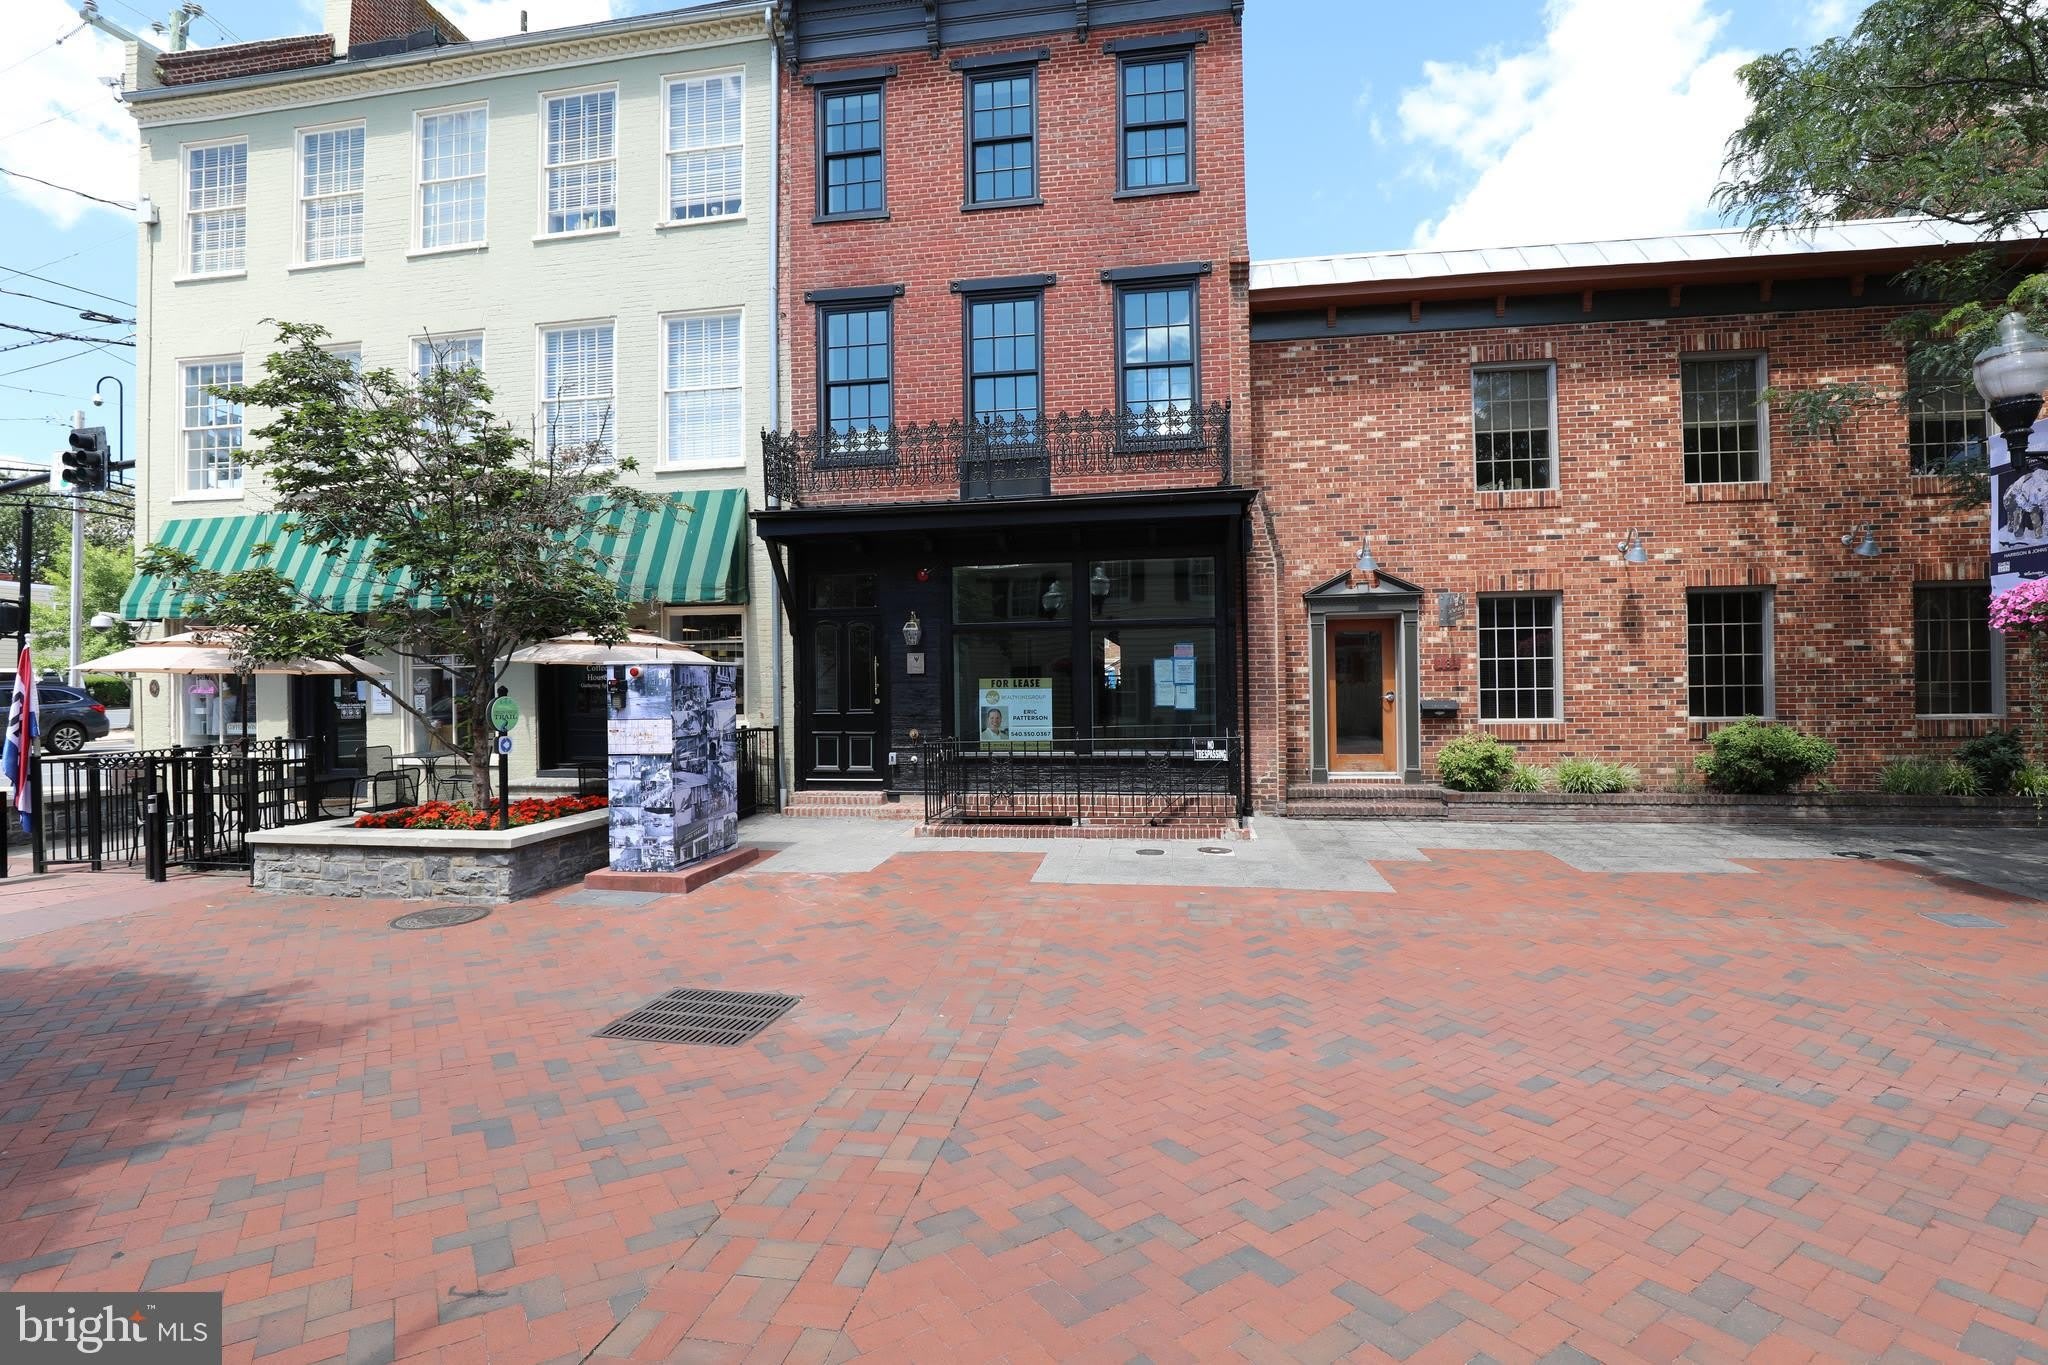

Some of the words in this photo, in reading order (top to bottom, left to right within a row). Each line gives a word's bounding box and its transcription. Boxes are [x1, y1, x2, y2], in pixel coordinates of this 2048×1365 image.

[991, 679, 1009, 688] FOR
[1013, 679, 1040, 688] LEASE
[1207, 740, 1214, 750] NO
[1195, 749, 1227, 759] TRESPASSING
